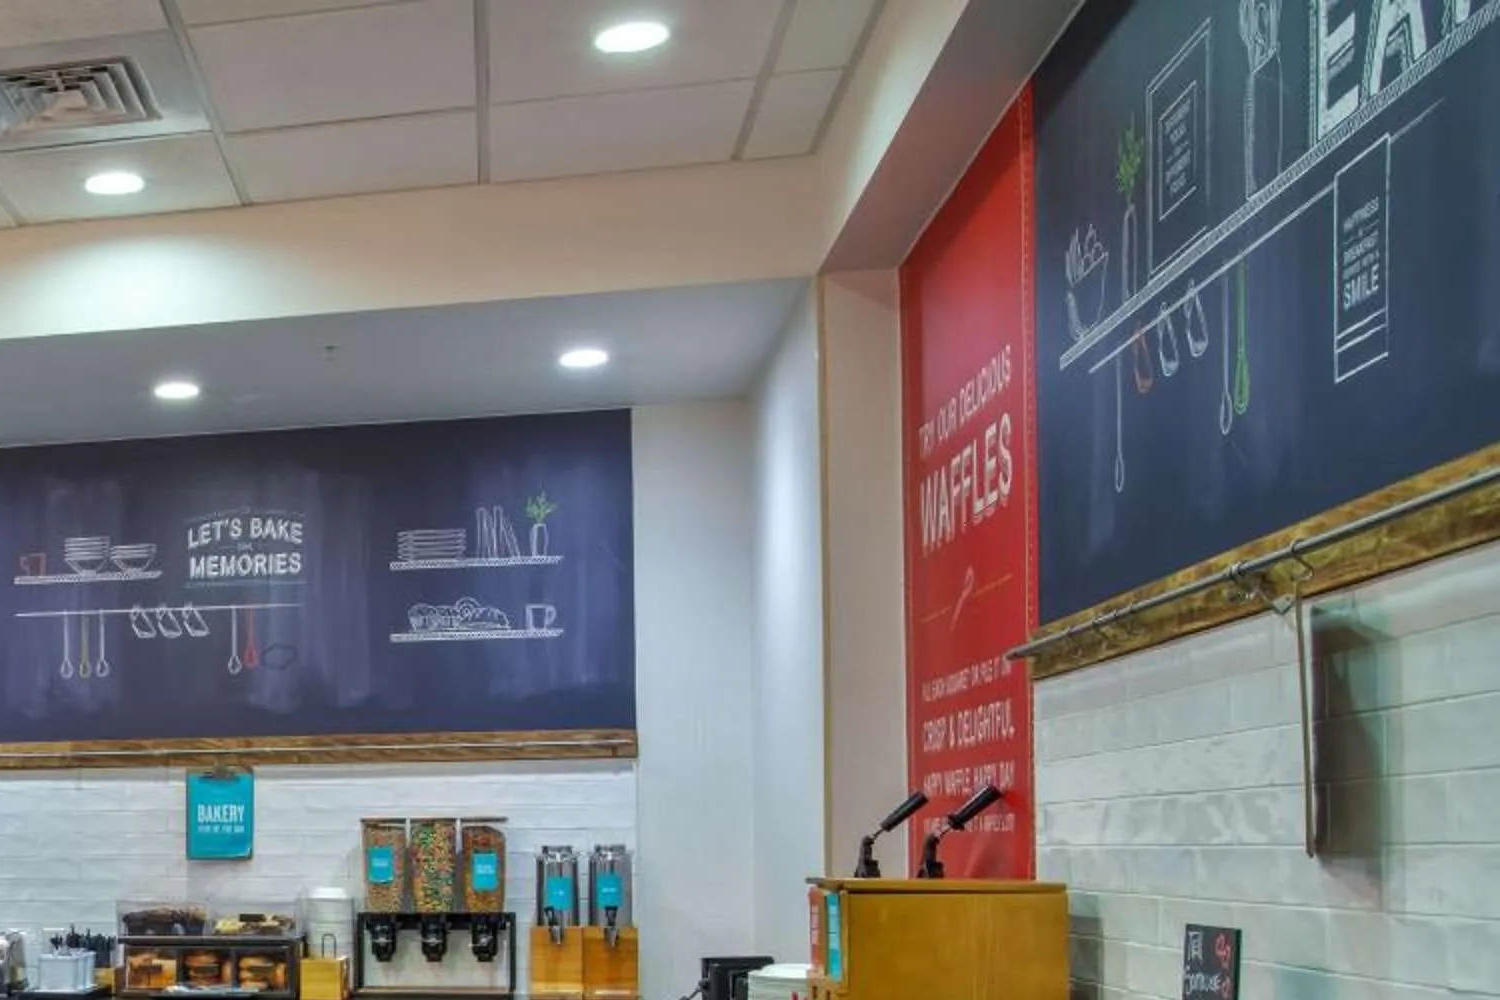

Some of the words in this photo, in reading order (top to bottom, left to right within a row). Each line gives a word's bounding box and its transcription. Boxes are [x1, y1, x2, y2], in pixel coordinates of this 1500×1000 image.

[1343, 263, 1379, 312] SMILE
[959, 344, 1011, 426] DELICIOUS
[920, 412, 1013, 549] WAFFLES
[187, 518, 242, 549] LET'S
[250, 517, 303, 544] BAKE
[189, 552, 301, 579] MEMORIES
[957, 699, 1015, 746] DELIGHTFUL
[197, 803, 245, 822] BAKERY
